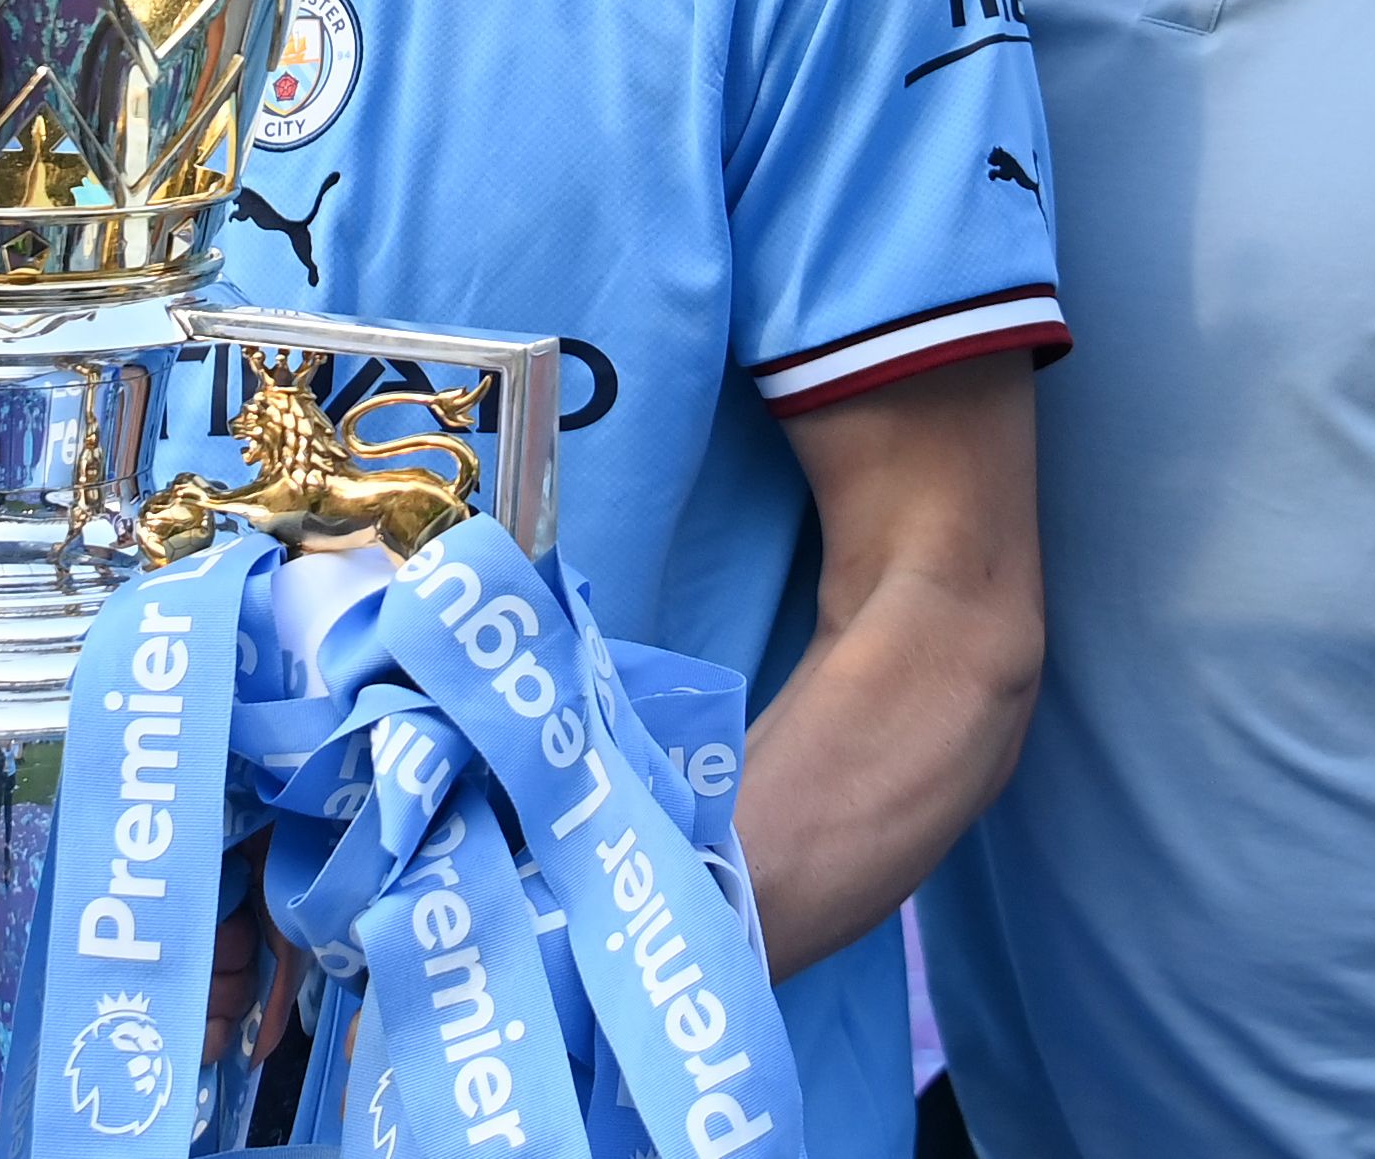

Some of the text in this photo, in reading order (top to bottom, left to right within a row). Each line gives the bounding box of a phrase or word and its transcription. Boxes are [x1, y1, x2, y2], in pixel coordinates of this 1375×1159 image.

[264, 119, 307, 138] CITY
[77, 602, 193, 961] Premier
[395, 538, 612, 840] League
[595, 827, 774, 1159] Premier
